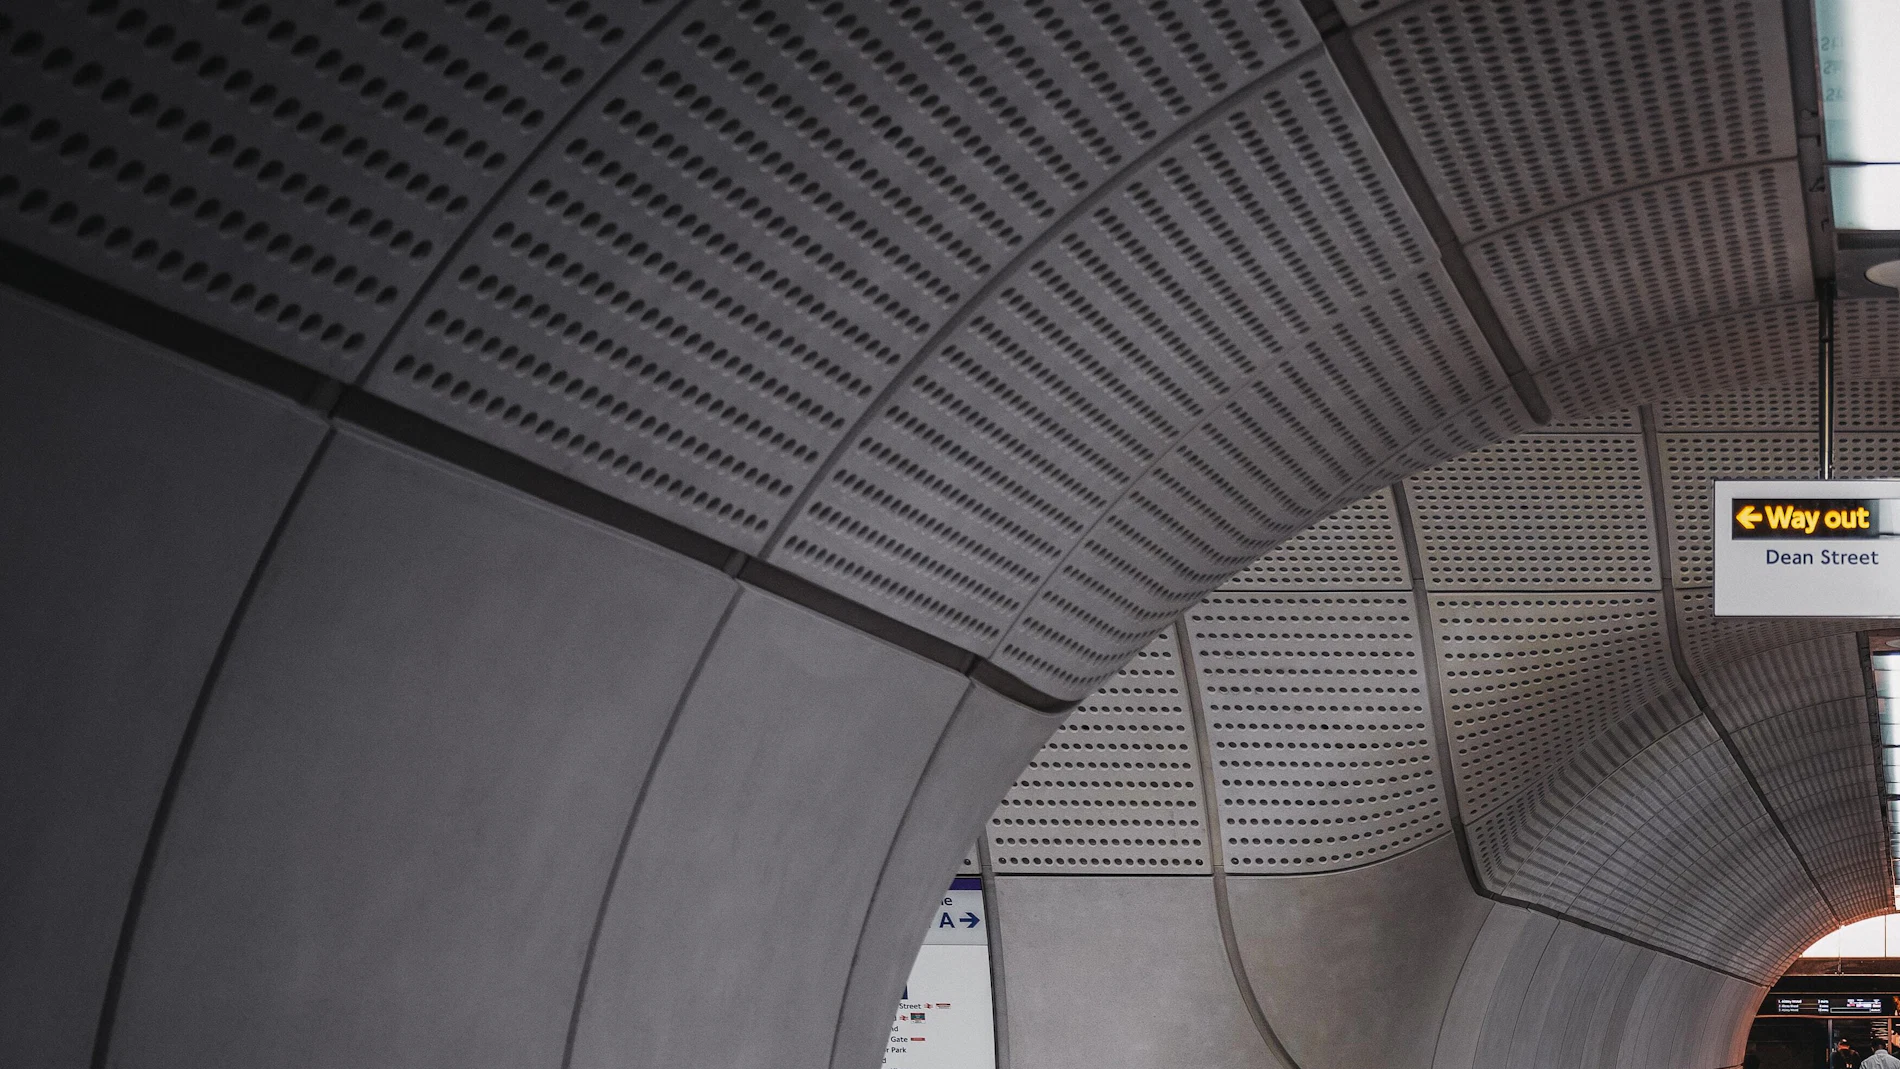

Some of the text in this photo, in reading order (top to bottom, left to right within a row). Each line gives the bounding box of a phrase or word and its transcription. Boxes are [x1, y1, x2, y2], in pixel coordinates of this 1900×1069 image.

[1764, 505, 1870, 534] Way out
[1766, 549, 1879, 565] Dean Street
[939, 912, 955, 928] A
